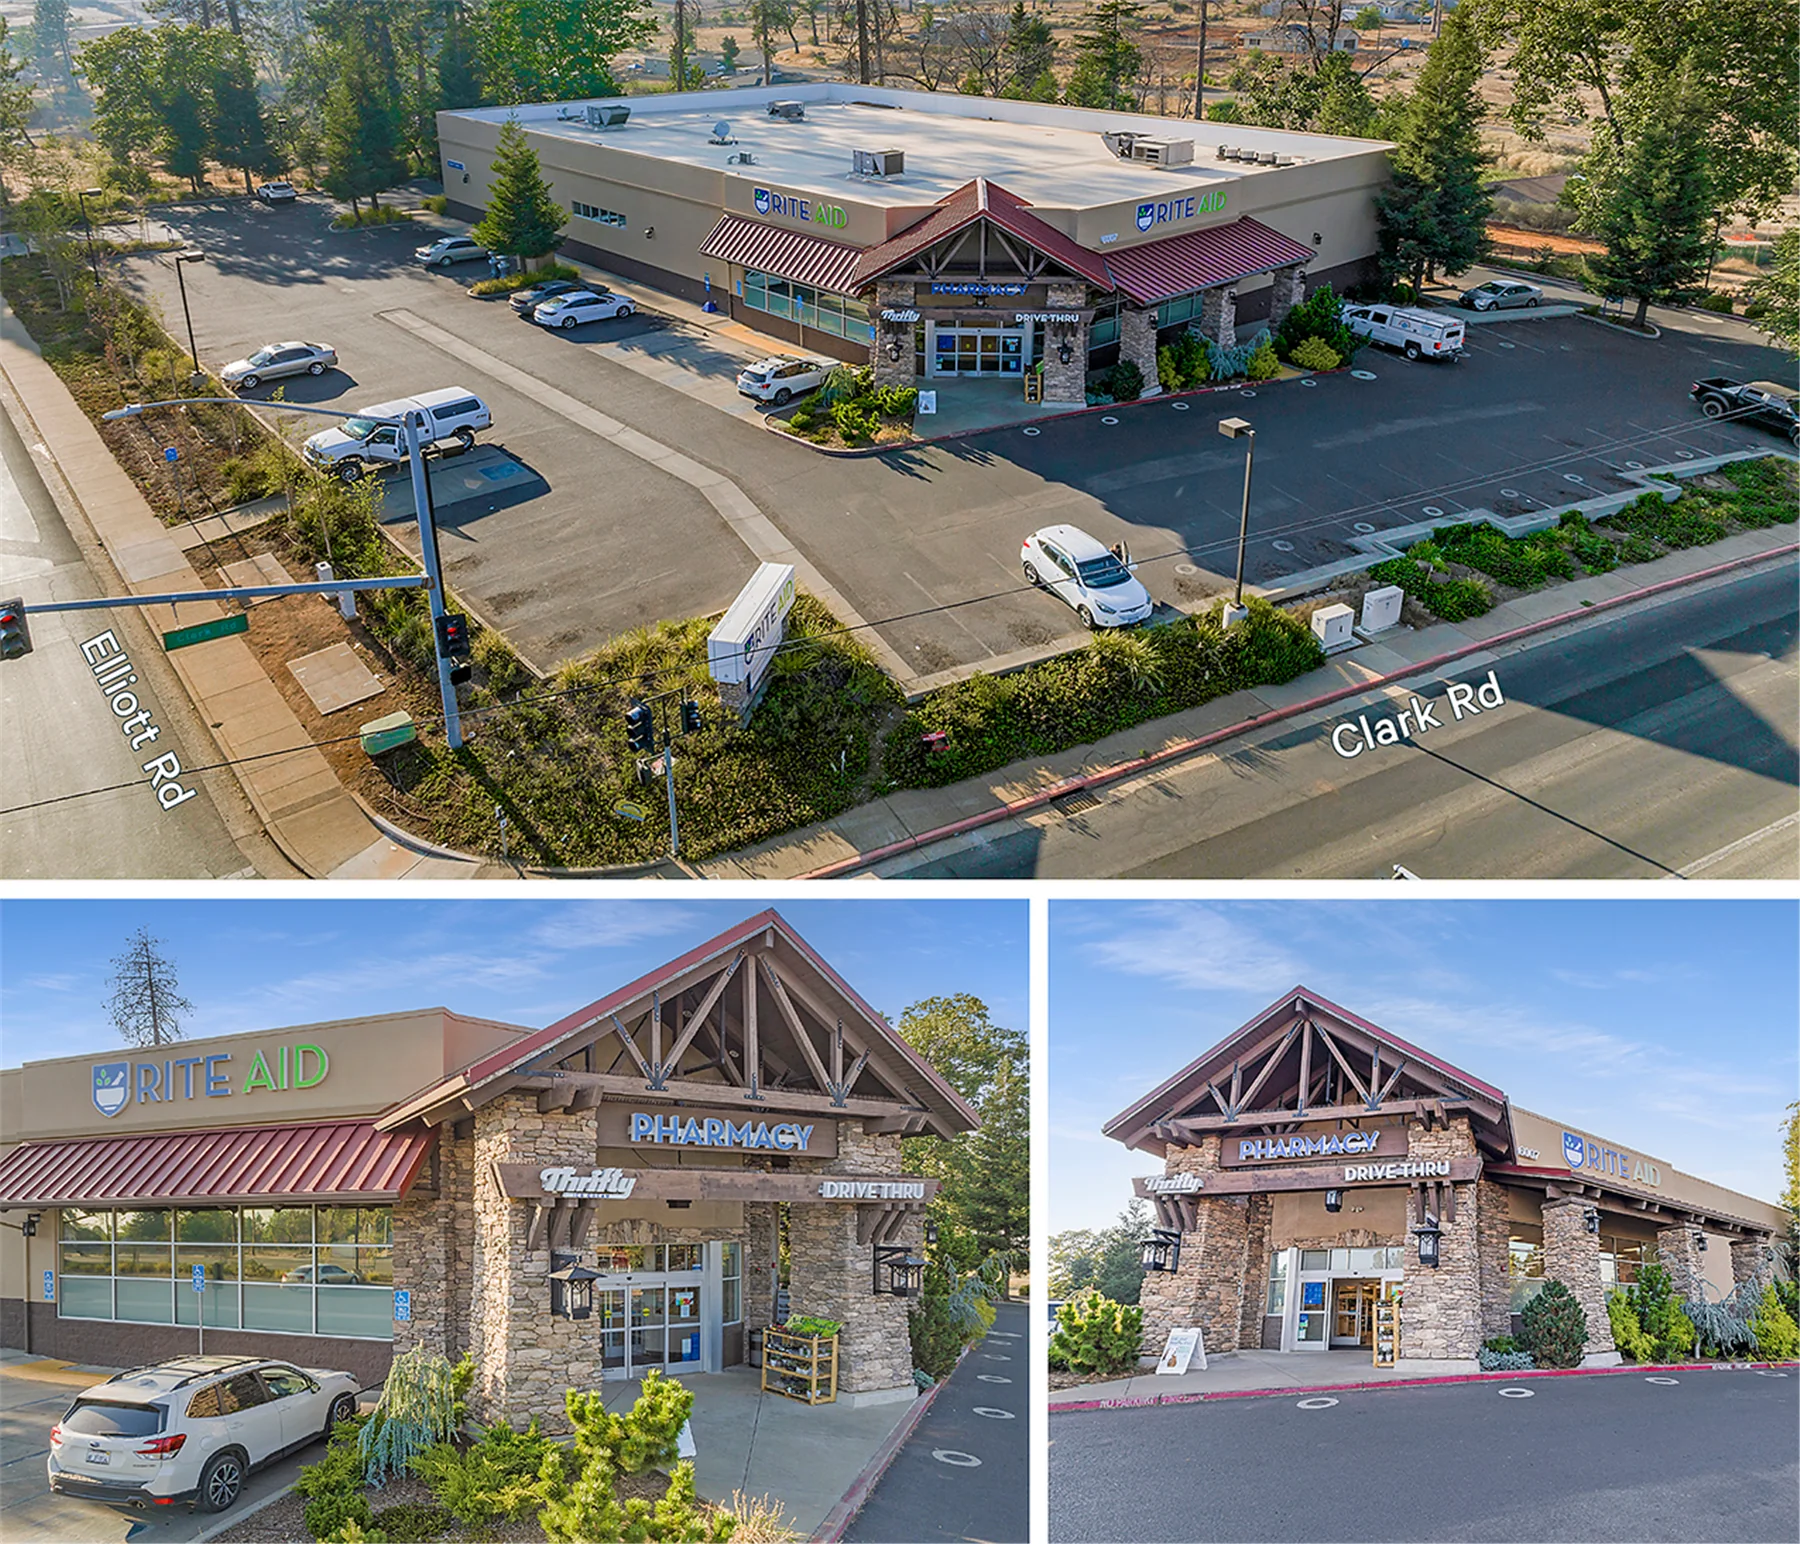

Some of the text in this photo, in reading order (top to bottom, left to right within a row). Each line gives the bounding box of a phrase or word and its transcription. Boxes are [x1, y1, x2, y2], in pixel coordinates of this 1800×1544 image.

[772, 192, 848, 229] RITE AID
[1156, 191, 1228, 224] RITE AID
[931, 283, 1029, 296] PHARMACY
[880, 309, 921, 322] Thrifty
[755, 580, 793, 648] RITE AID
[136, 1044, 329, 1103] RITE AID
[630, 1112, 814, 1150] PHARMACY
[1239, 1130, 1380, 1160] PHARMACY
[1587, 1142, 1662, 1188] RITE AID
[540, 1166, 637, 1200] Thrifty
[1144, 1171, 1205, 1194] Thrifty
